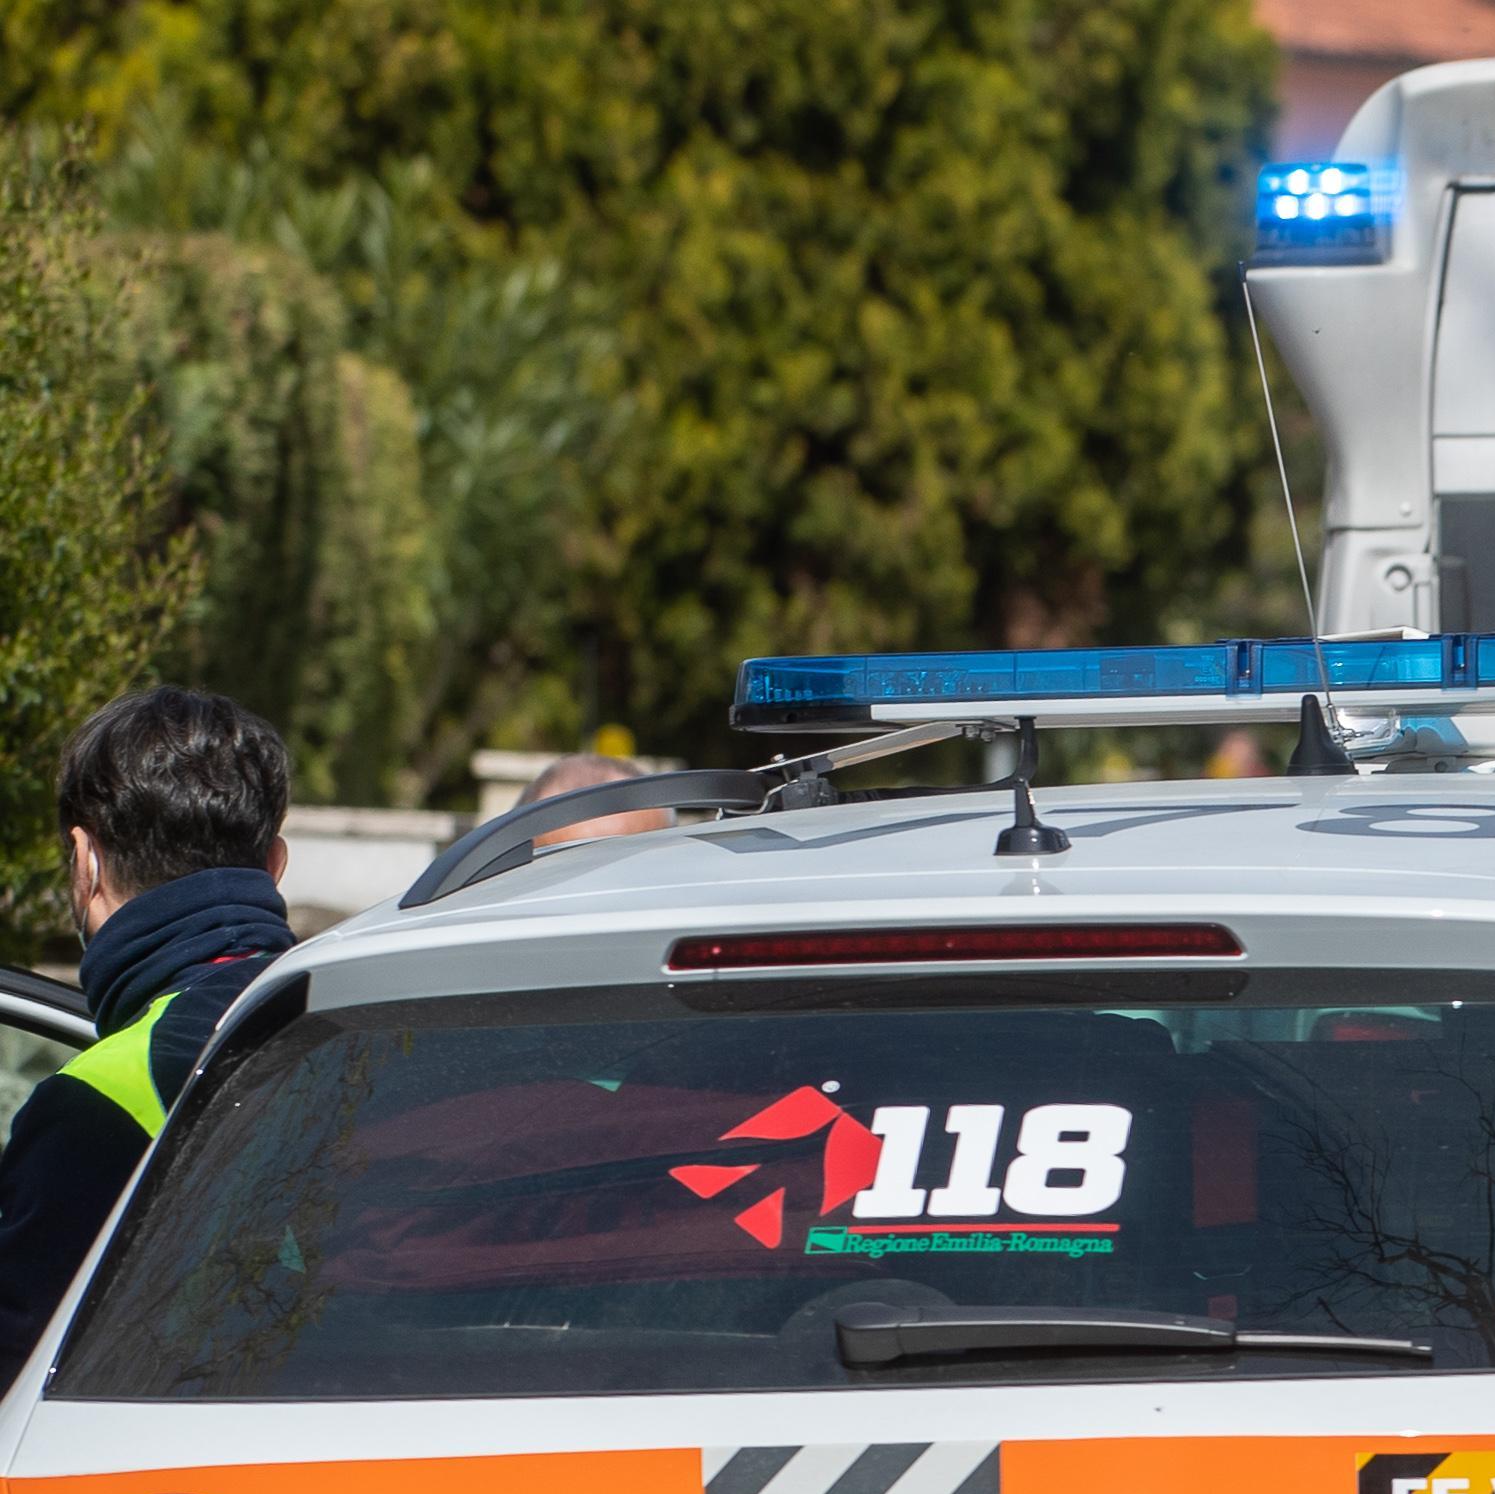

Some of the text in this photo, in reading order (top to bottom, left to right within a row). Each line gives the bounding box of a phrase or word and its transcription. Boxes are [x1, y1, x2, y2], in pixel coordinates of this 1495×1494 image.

[852, 1103, 1133, 1218] 118
[848, 1232, 1114, 1258] Regione Emilia-Romagna
